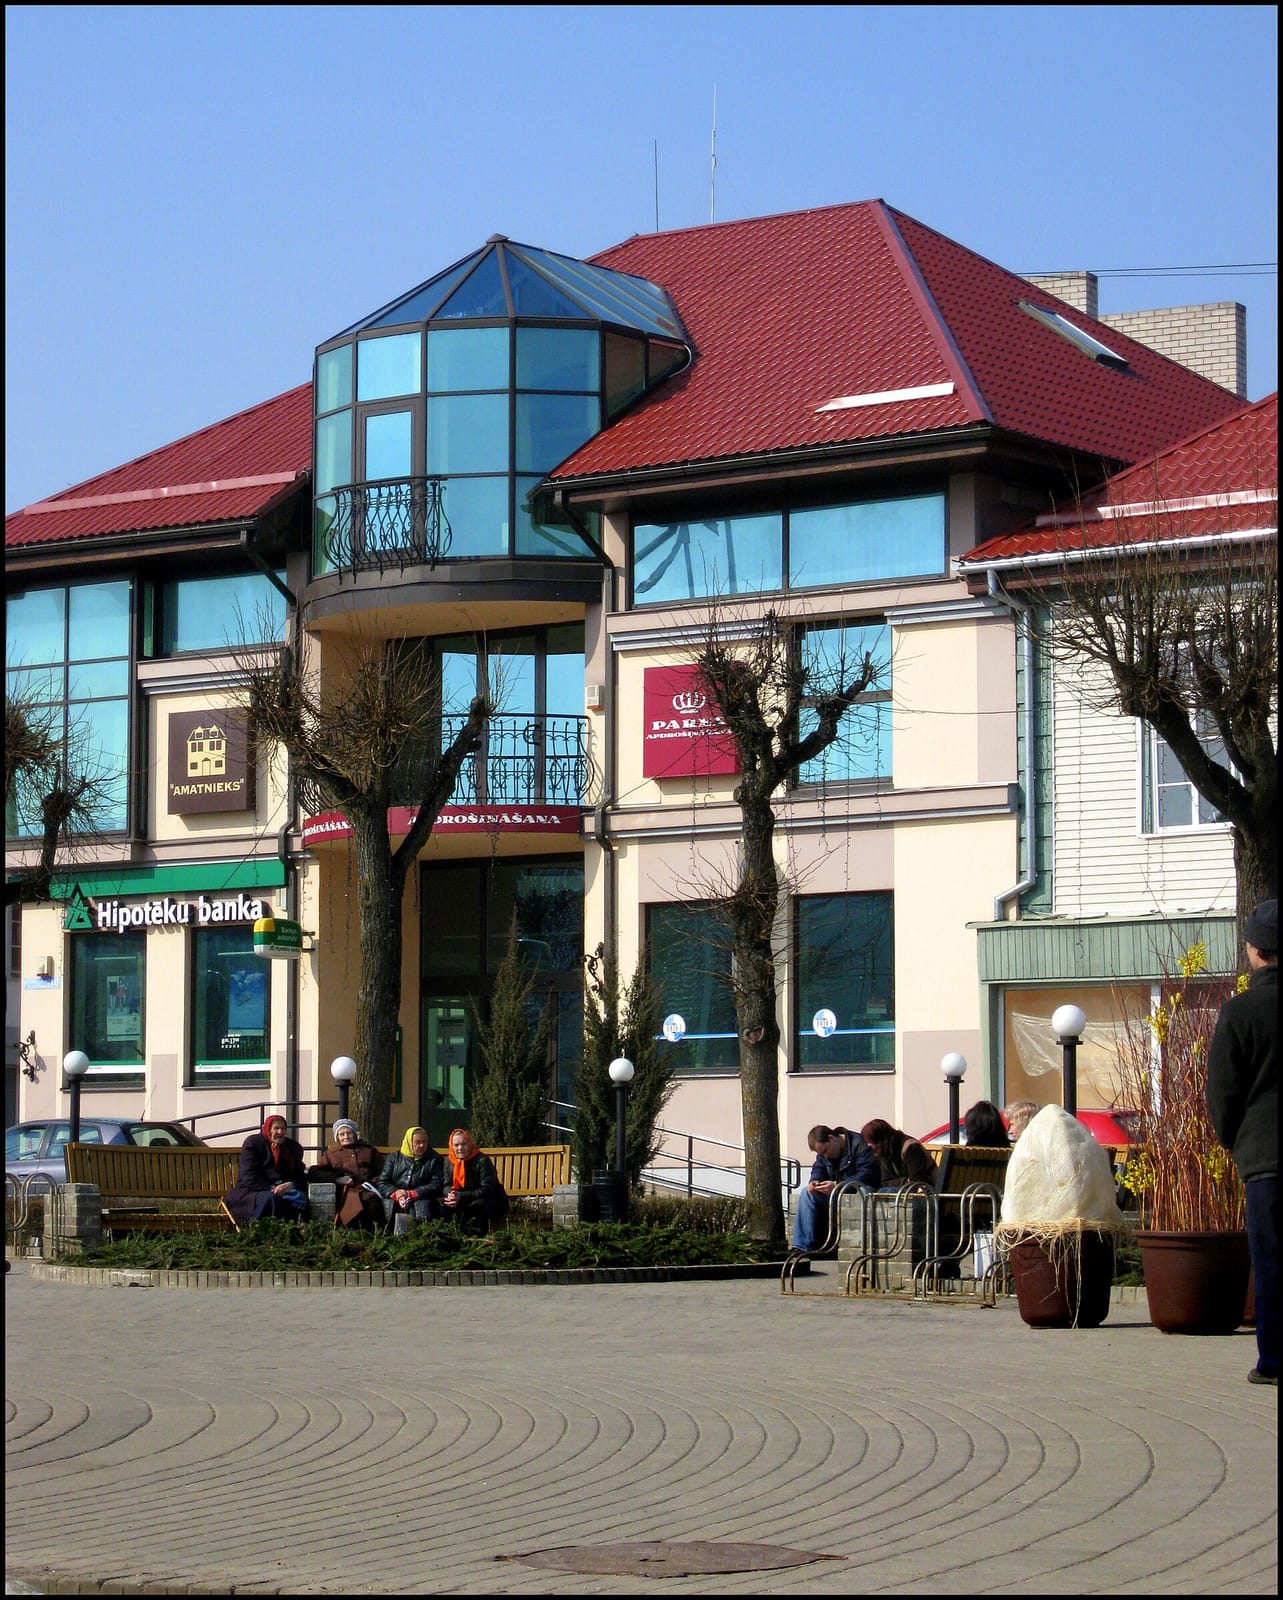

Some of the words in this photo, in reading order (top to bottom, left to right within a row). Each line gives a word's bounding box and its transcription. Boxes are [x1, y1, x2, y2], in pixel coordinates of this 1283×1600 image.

[169, 777, 245, 797] "AMATNIEKS"
[408, 812, 561, 825] ADROŠINĀŠANA
[97, 897, 189, 934] Hipotēku
[198, 893, 263, 922] banka
